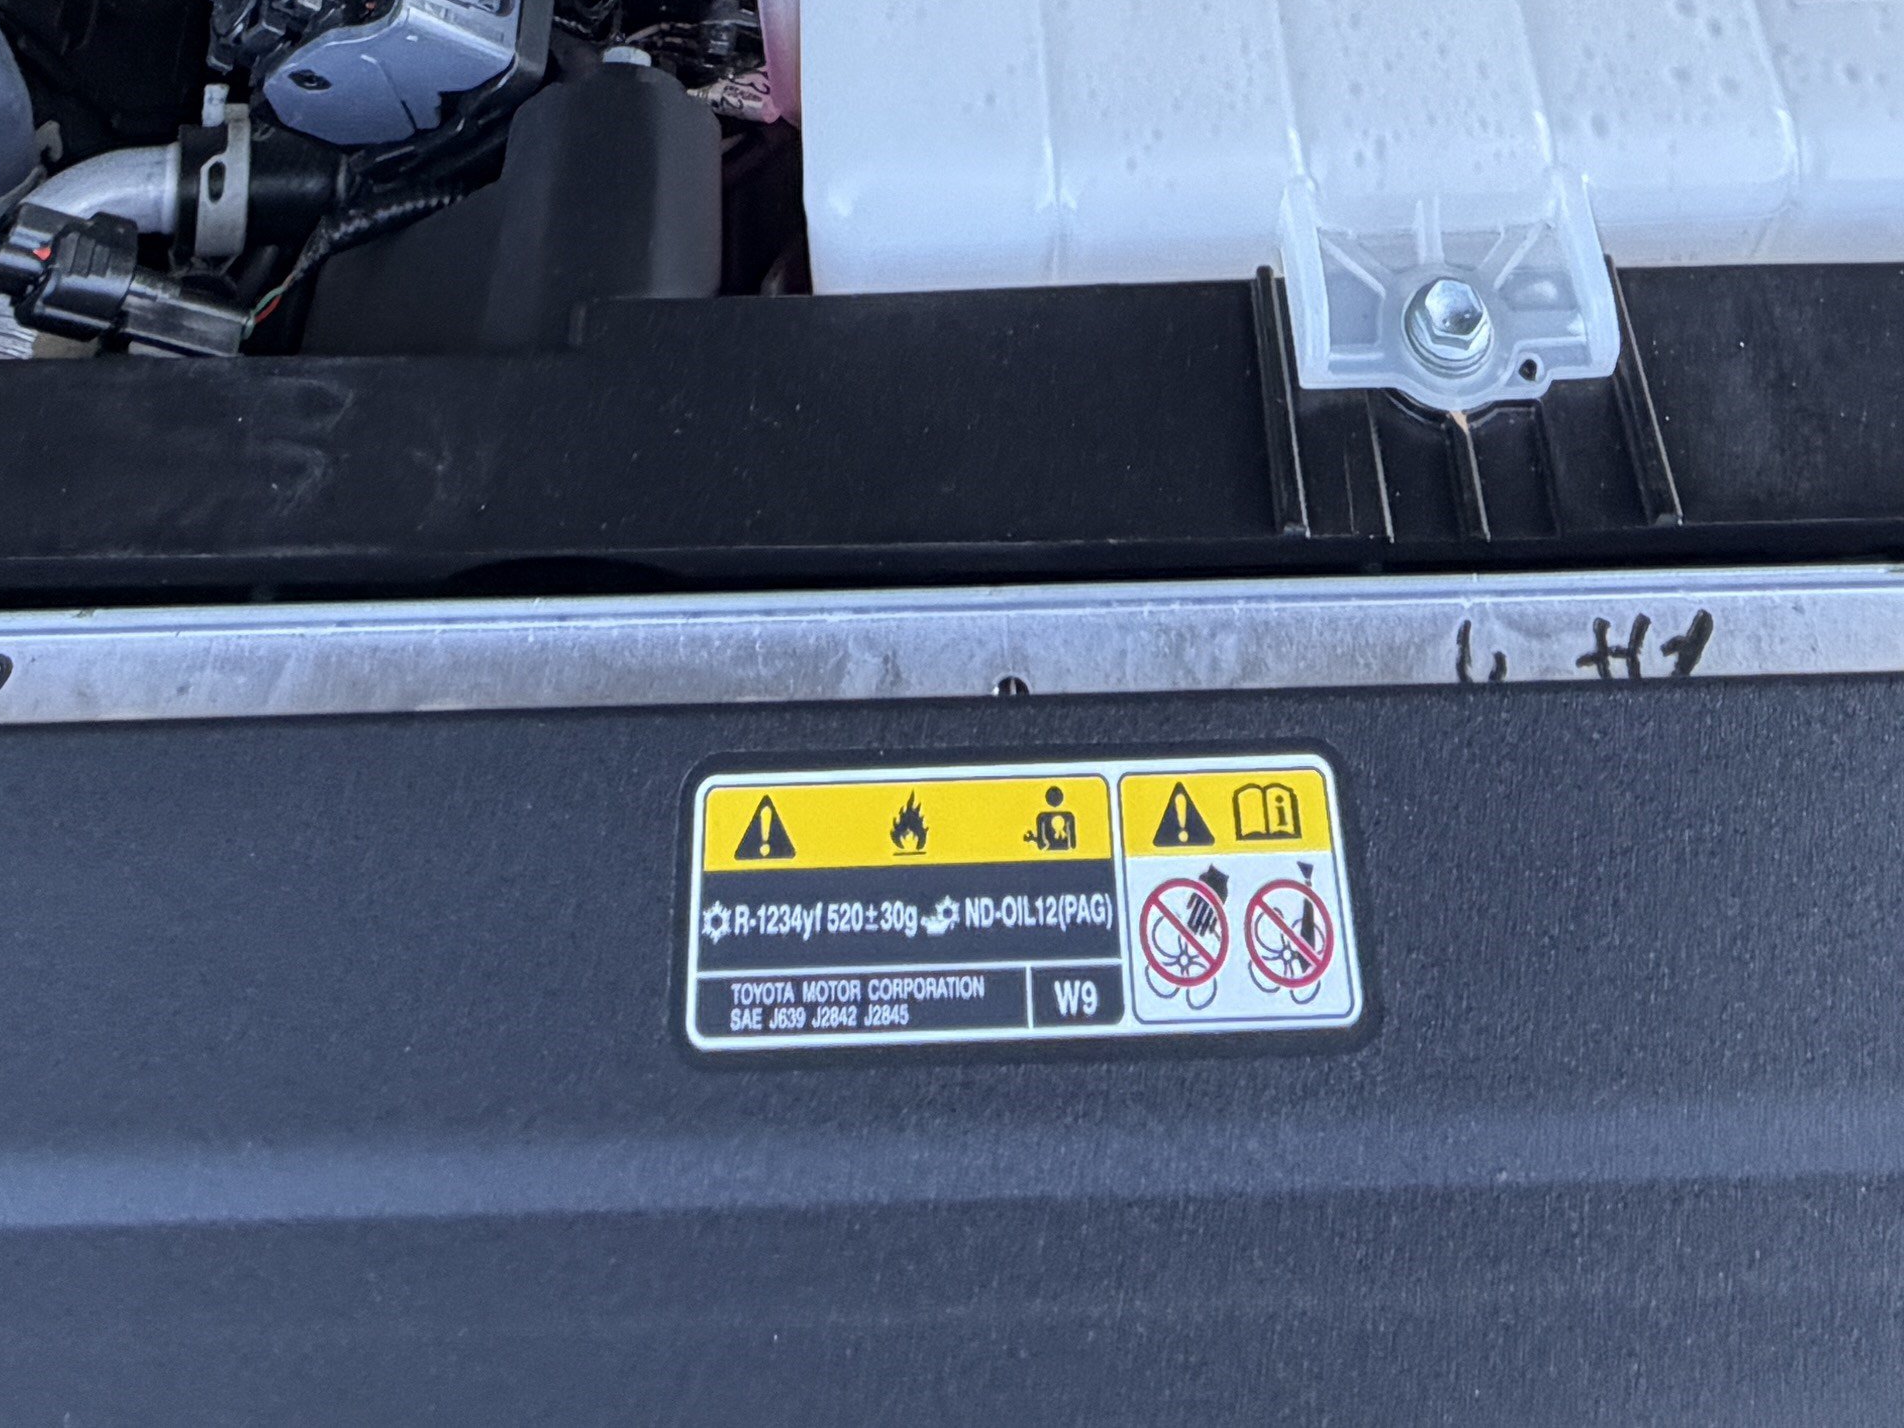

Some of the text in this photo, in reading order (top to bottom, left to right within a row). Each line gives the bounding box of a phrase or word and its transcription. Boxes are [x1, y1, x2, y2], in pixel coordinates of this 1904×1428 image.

[734, 893, 1114, 941] R-1234yf 520±30g ND-OIL12(PAG)
[731, 974, 986, 1005] TOYOTA MOTOR CORPORATION
[1053, 980, 1099, 1016] W9
[729, 1003, 910, 1029] SAE J639 J2842 J2845
